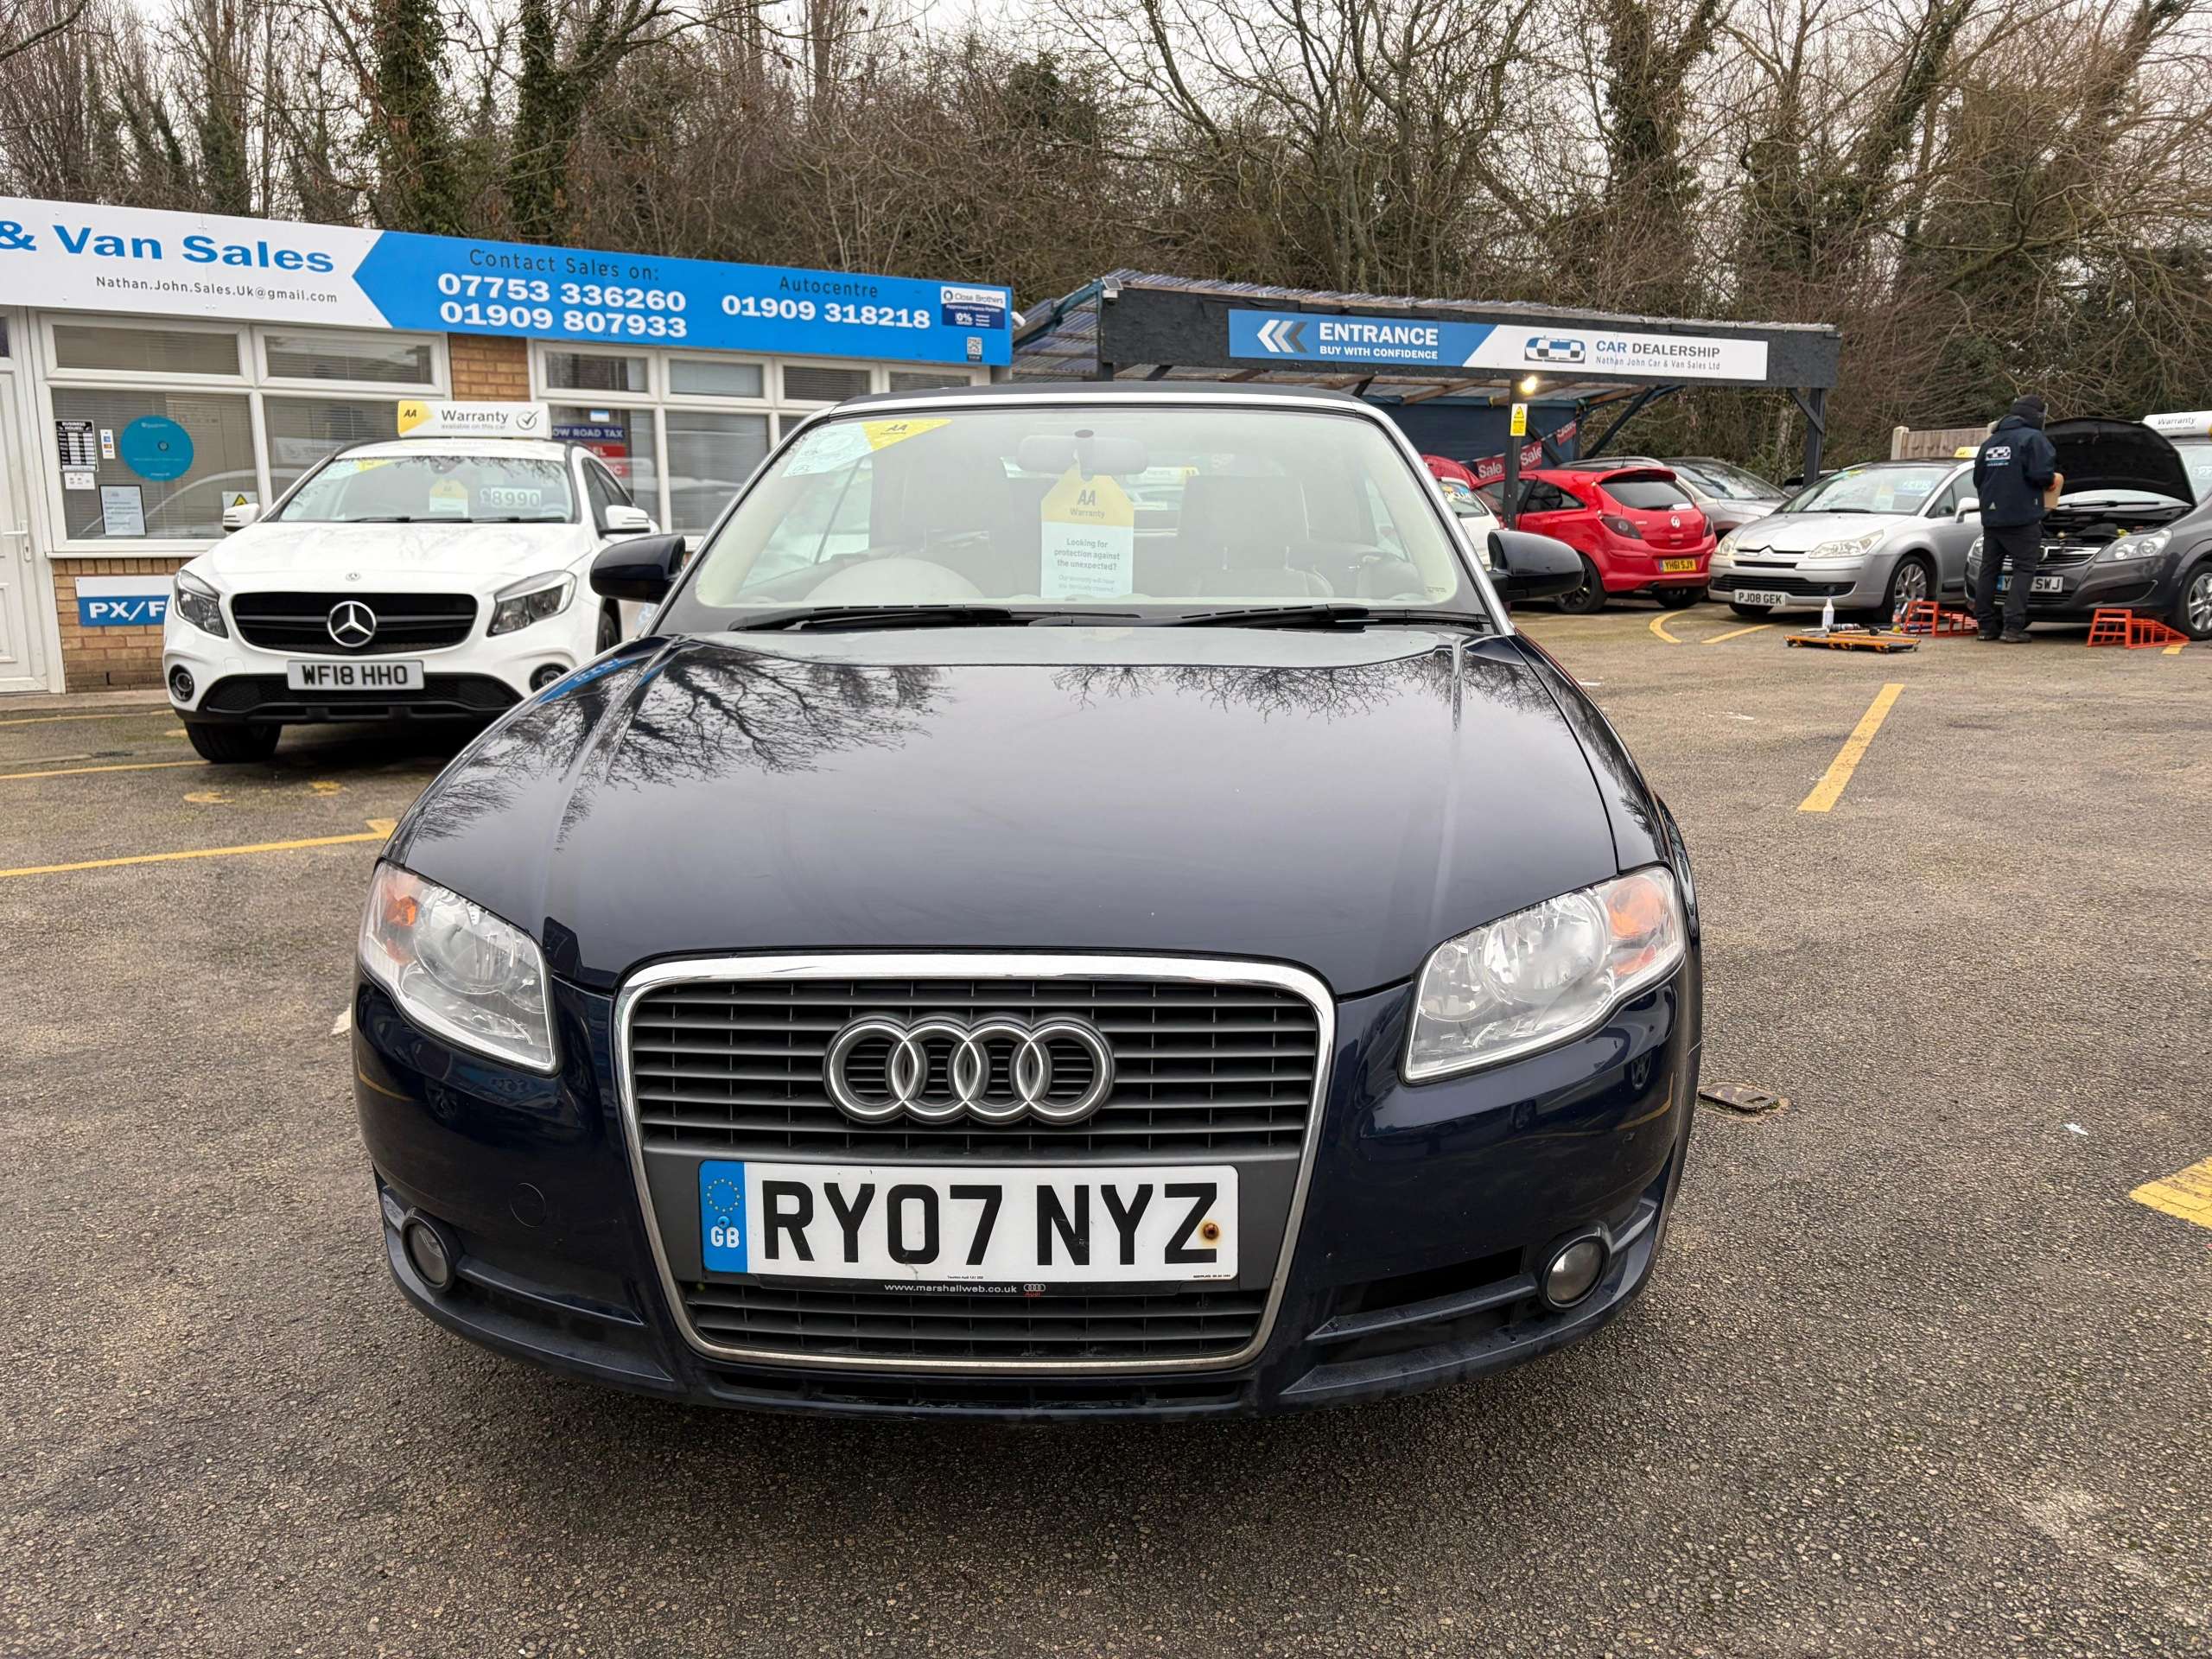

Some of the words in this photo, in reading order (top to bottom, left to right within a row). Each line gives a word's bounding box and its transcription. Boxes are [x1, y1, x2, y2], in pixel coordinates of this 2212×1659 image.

[0, 219, 36, 252] &
[53, 225, 162, 260] Van
[182, 235, 334, 273] Sales
[469, 248, 556, 272] Contact
[566, 257, 619, 277] Sales
[629, 266, 659, 282] on:
[96, 276, 339, 304] Nathan.John.Sales.Uk@gmail.com
[437, 272, 550, 302] 07753
[560, 282, 686, 312] 336260
[779, 276, 878, 298] Autocentre
[976, 295, 1003, 304] Brothers
[440, 301, 554, 330] 01909
[563, 310, 688, 338] 807933
[721, 295, 817, 321] 01909
[823, 302, 931, 329] 318218
[1319, 322, 1439, 346] ENTRANCE
[1319, 346, 1341, 355] BUY
[1344, 346, 1370, 357] WITH
[1373, 348, 1439, 359] CONFIDENCE
[1596, 340, 1627, 353] CAR
[1632, 343, 1720, 358] DEALERSHIP
[1596, 356, 1624, 365] Nathan
[1627, 357, 1645, 367] John
[1648, 359, 1661, 367] Car
[1671, 359, 1685, 368] Van
[1688, 360, 1707, 370] Sales
[1708, 361, 1720, 370] Ltd
[404, 410, 417, 418] AA
[442, 410, 509, 424] Warranty
[2158, 416, 2196, 425] Warranty
[553, 428, 570, 437] OW
[573, 428, 602, 437] ROAD
[603, 429, 624, 438] TAX
[1521, 447, 1542, 467] Sale
[1478, 462, 1503, 479] Sale
[480, 487, 541, 507] £8990
[1077, 489, 1096, 506] AA
[1070, 507, 1106, 518] Warranty
[1066, 538, 1096, 549] Looking
[1097, 539, 1109, 548] for
[1053, 550, 1092, 560] protection
[1093, 552, 1121, 562] against
[1070, 561, 1117, 571] unexpected?
[2035, 578, 2061, 590] SWJ
[1738, 592, 1761, 603] PJ08
[1763, 594, 1782, 604] GEK
[302, 665, 354, 685] WF18
[361, 665, 408, 685] HHO
[710, 1225, 740, 1248] GB
[762, 1179, 1002, 1266] RY07
[1037, 1183, 1217, 1266] NYZ
[884, 1283, 1017, 1294] www.marshallweb.co.uk
